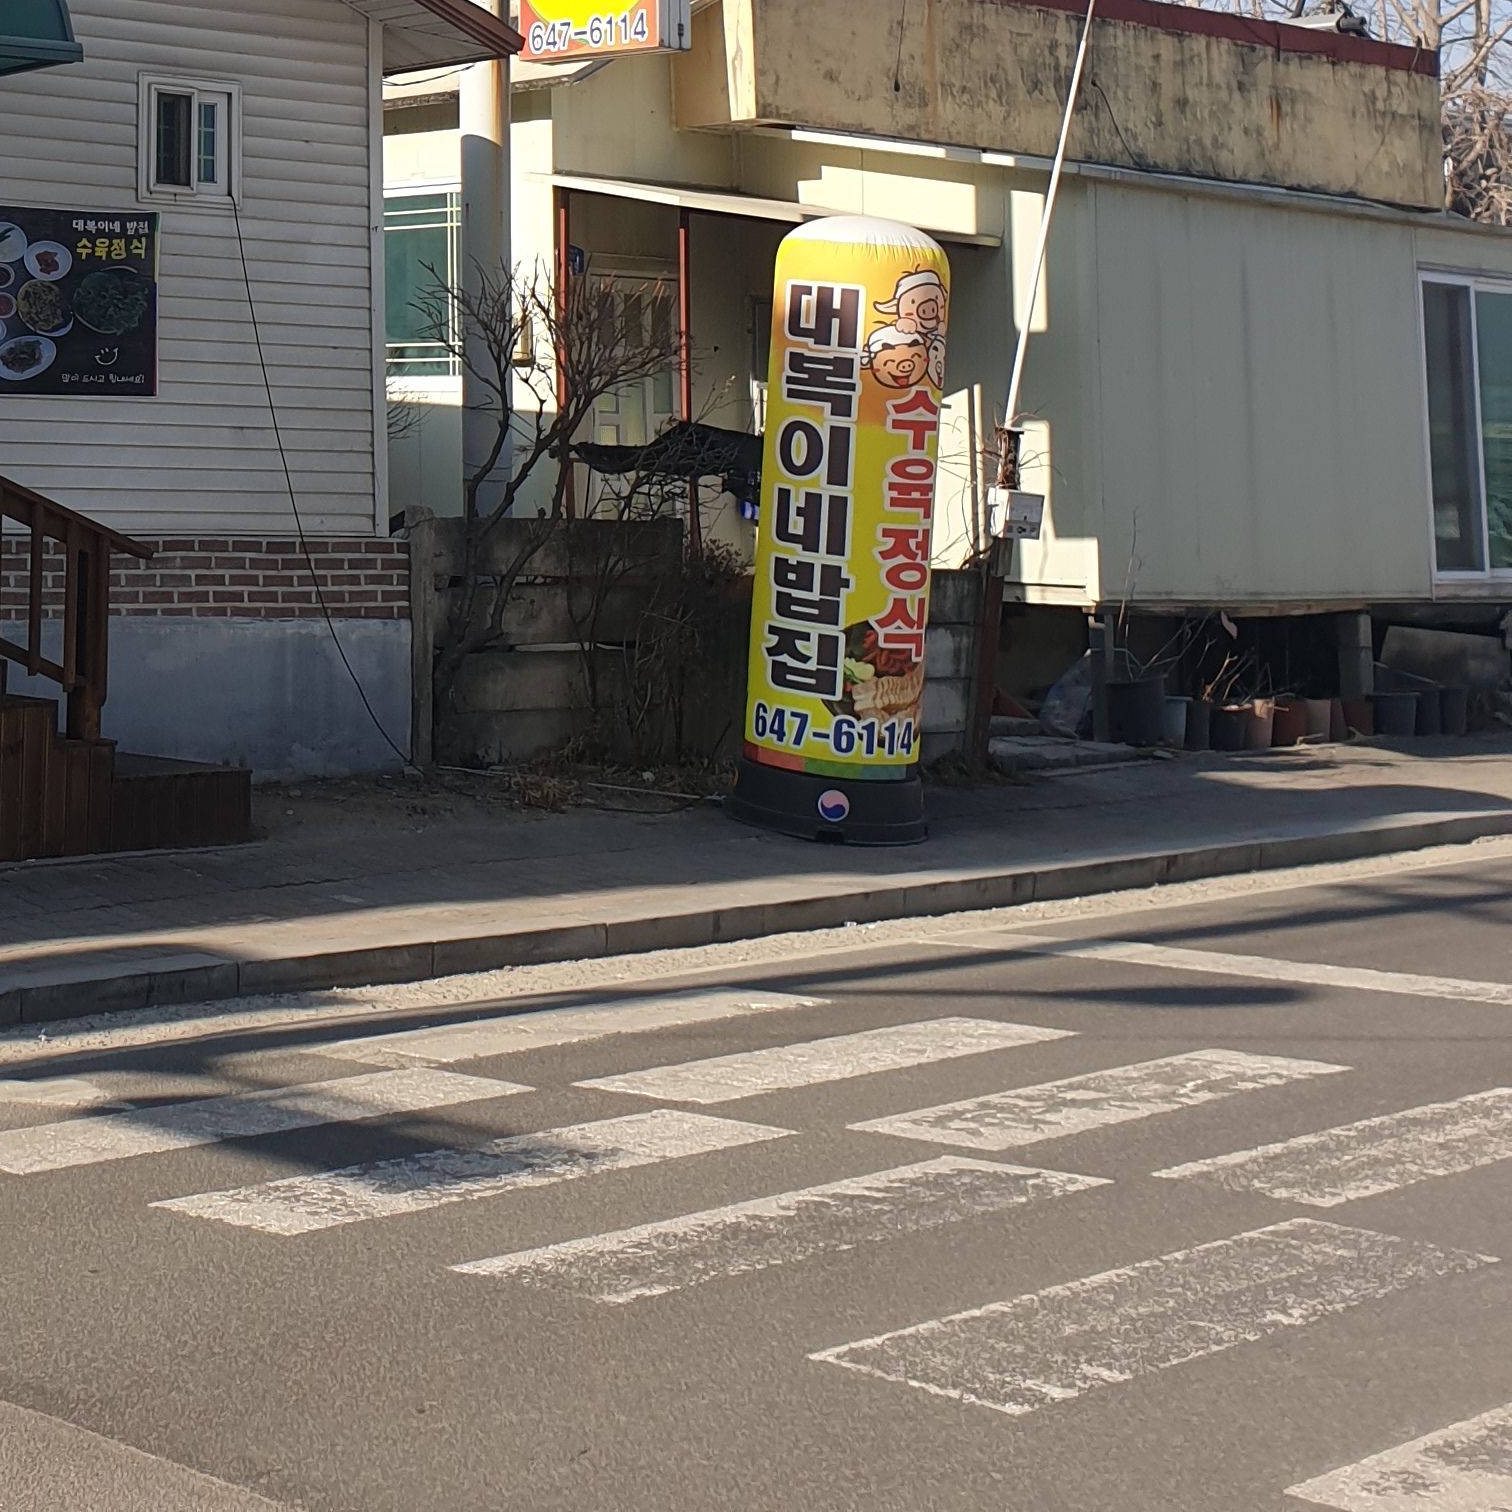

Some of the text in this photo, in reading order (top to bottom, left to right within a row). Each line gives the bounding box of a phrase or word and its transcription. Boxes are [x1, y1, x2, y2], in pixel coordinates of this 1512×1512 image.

[530, 11, 647, 52] 647-6114
[72, 219, 149, 235] 대복이네 밥집
[76, 236, 147, 261] 수육정식
[875, 390, 938, 659] 수육정식
[753, 702, 914, 756] 647-6114
